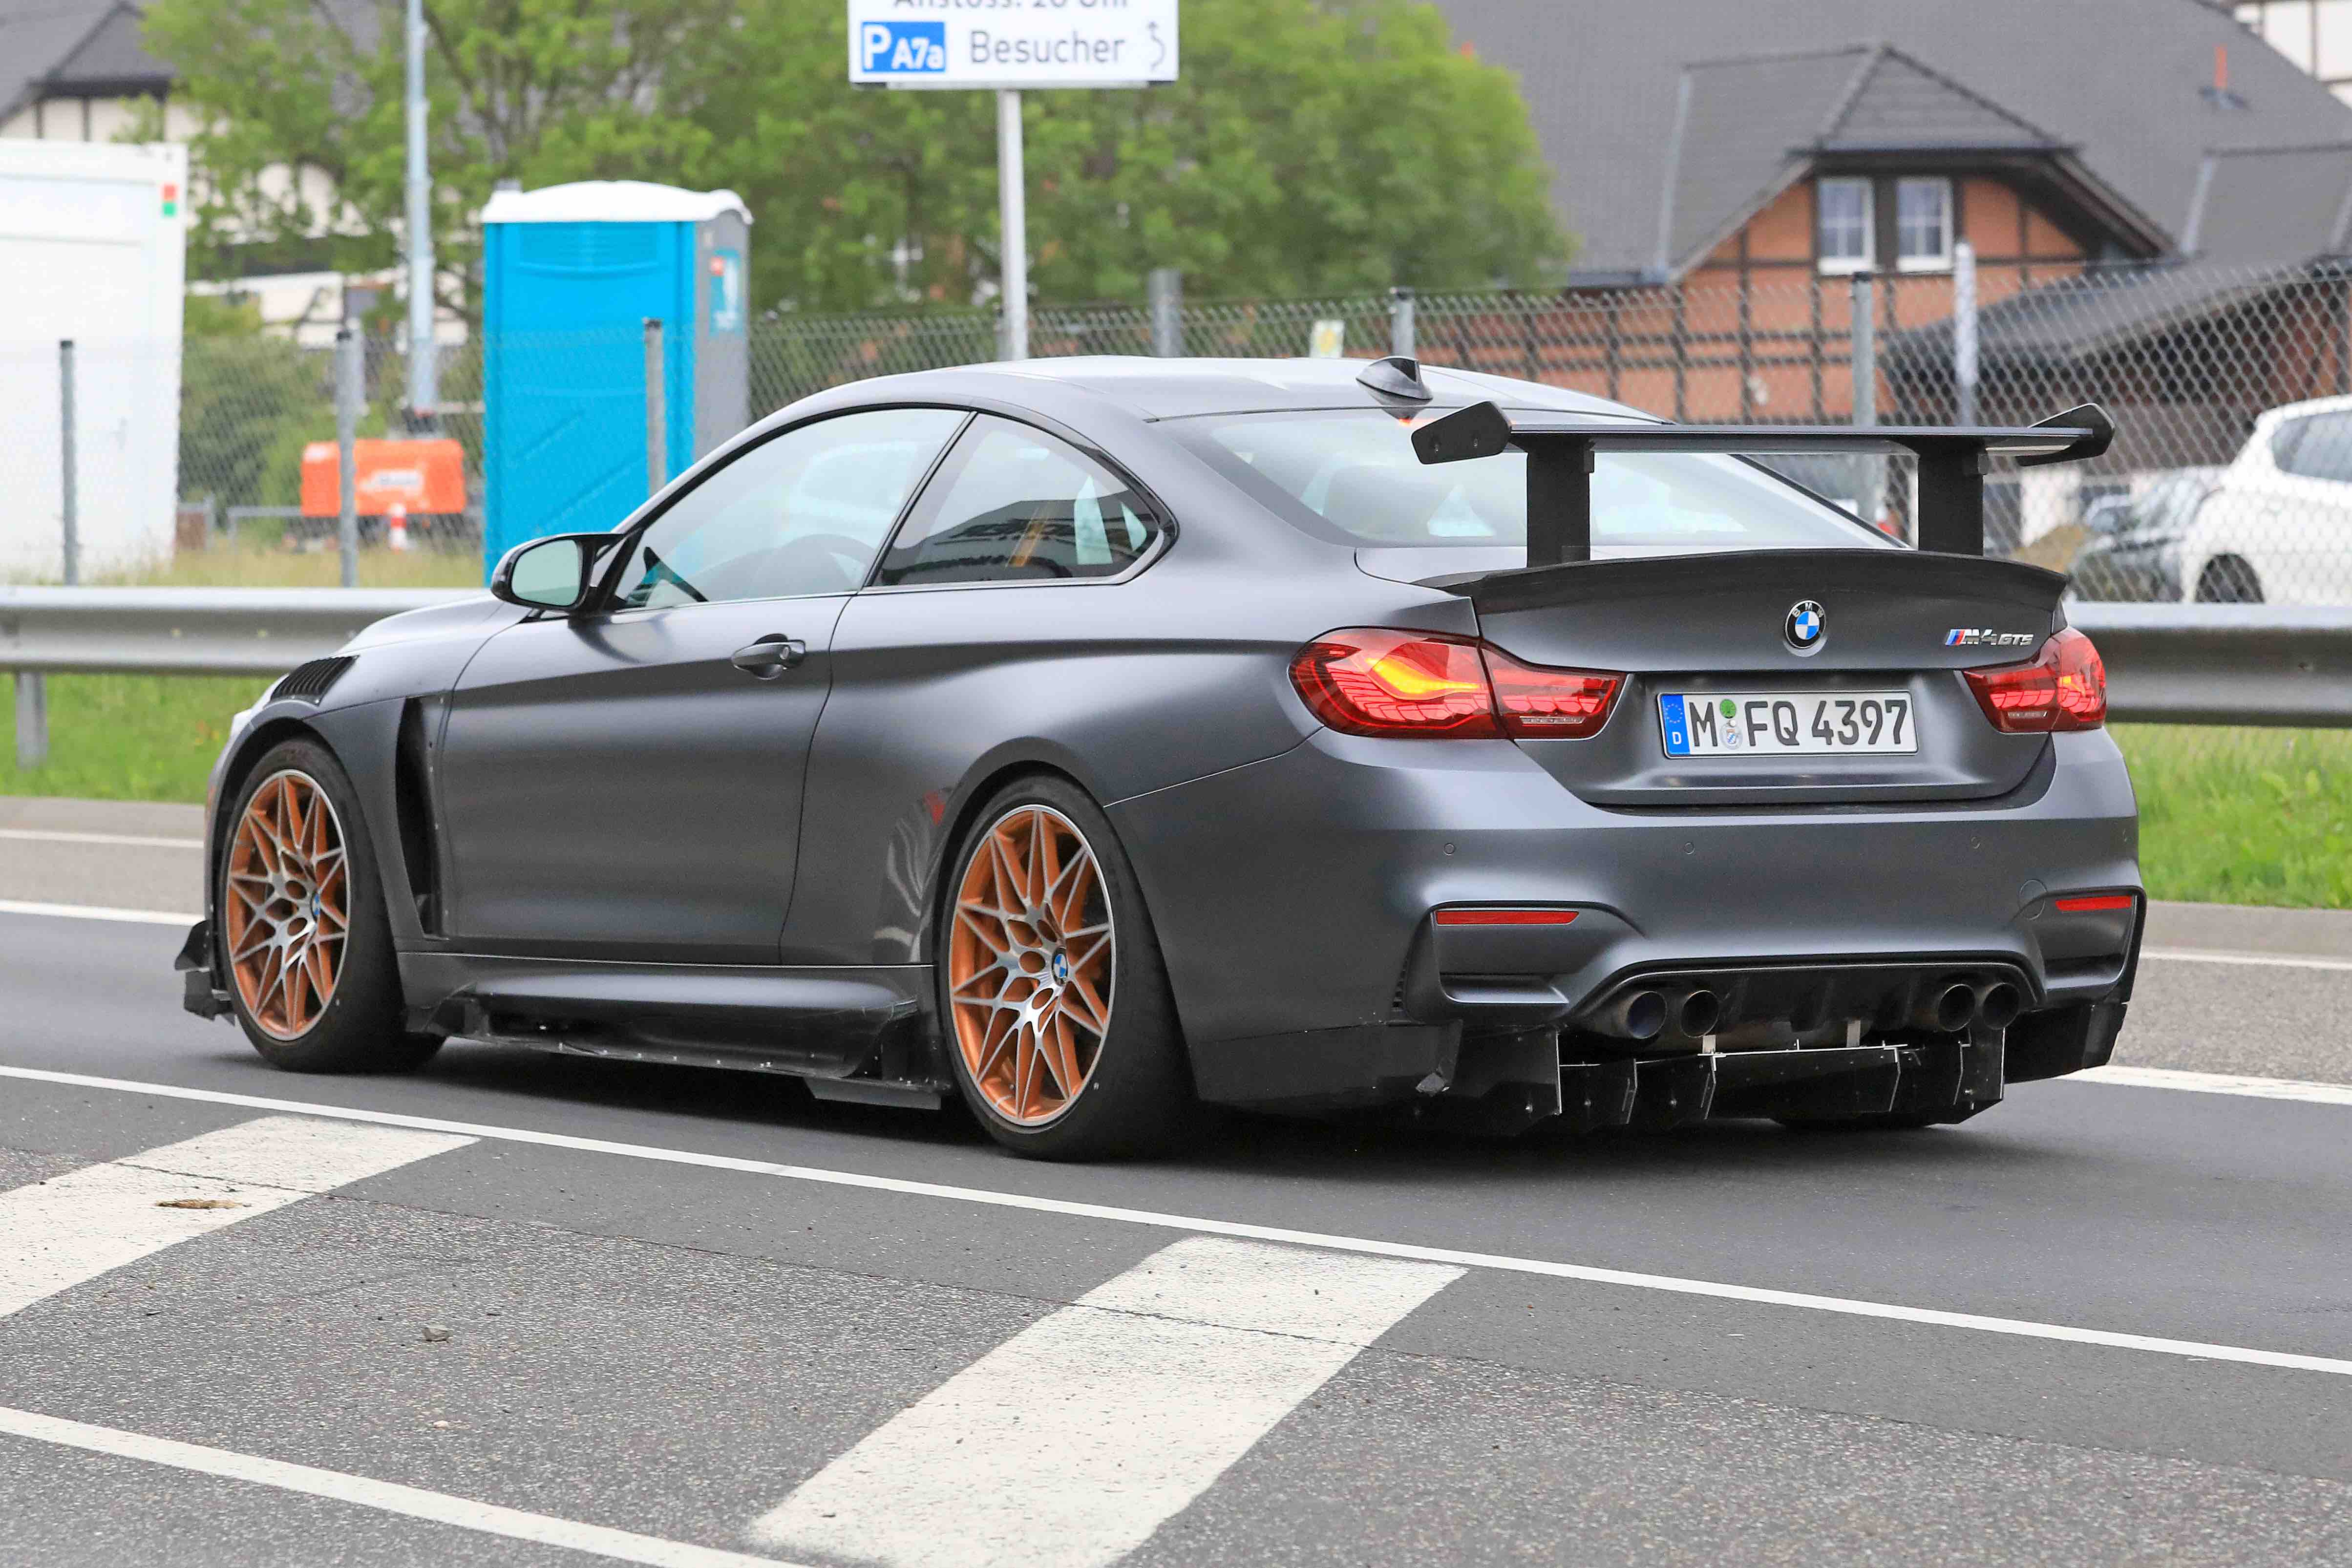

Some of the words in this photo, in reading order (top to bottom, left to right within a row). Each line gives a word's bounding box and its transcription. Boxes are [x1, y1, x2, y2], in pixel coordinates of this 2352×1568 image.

[864, 25, 891, 69] P
[891, 36, 945, 69] A7a
[970, 30, 1126, 63] Besucher
[1792, 602, 1824, 618] BMW
[1998, 634, 2034, 645] GTS
[1689, 701, 1718, 747] M
[1744, 700, 1800, 746] FQ
[1811, 699, 1907, 745] 4397
[1672, 731, 1682, 745] D
